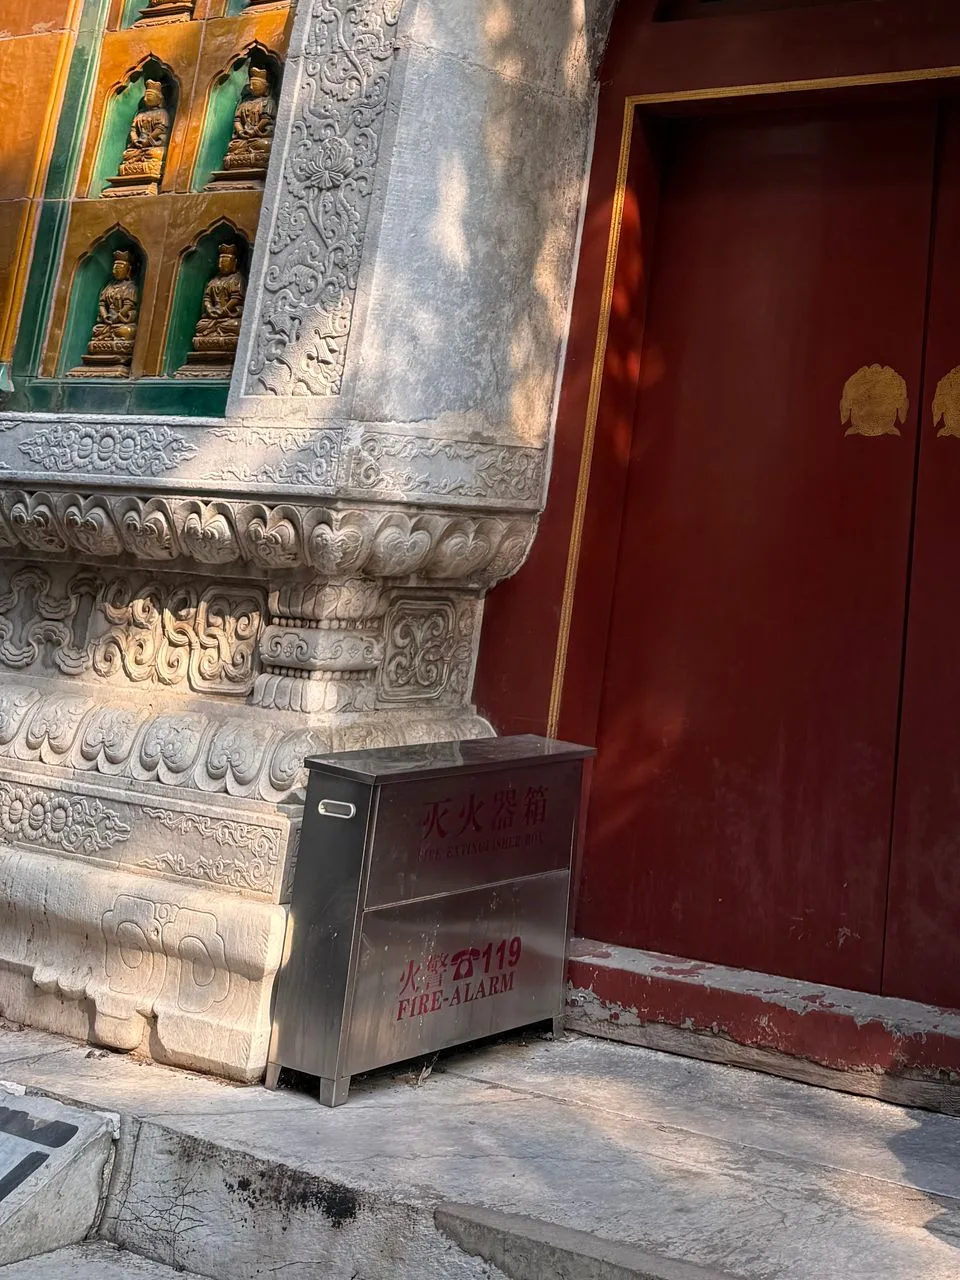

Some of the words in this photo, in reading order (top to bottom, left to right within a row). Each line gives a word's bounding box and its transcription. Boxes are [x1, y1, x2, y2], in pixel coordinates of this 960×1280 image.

[420, 785, 548, 840] 灭火器箱
[399, 953, 449, 996] 火警
[482, 936, 522, 974] 119
[397, 971, 515, 1021] FIRE-ALARM
